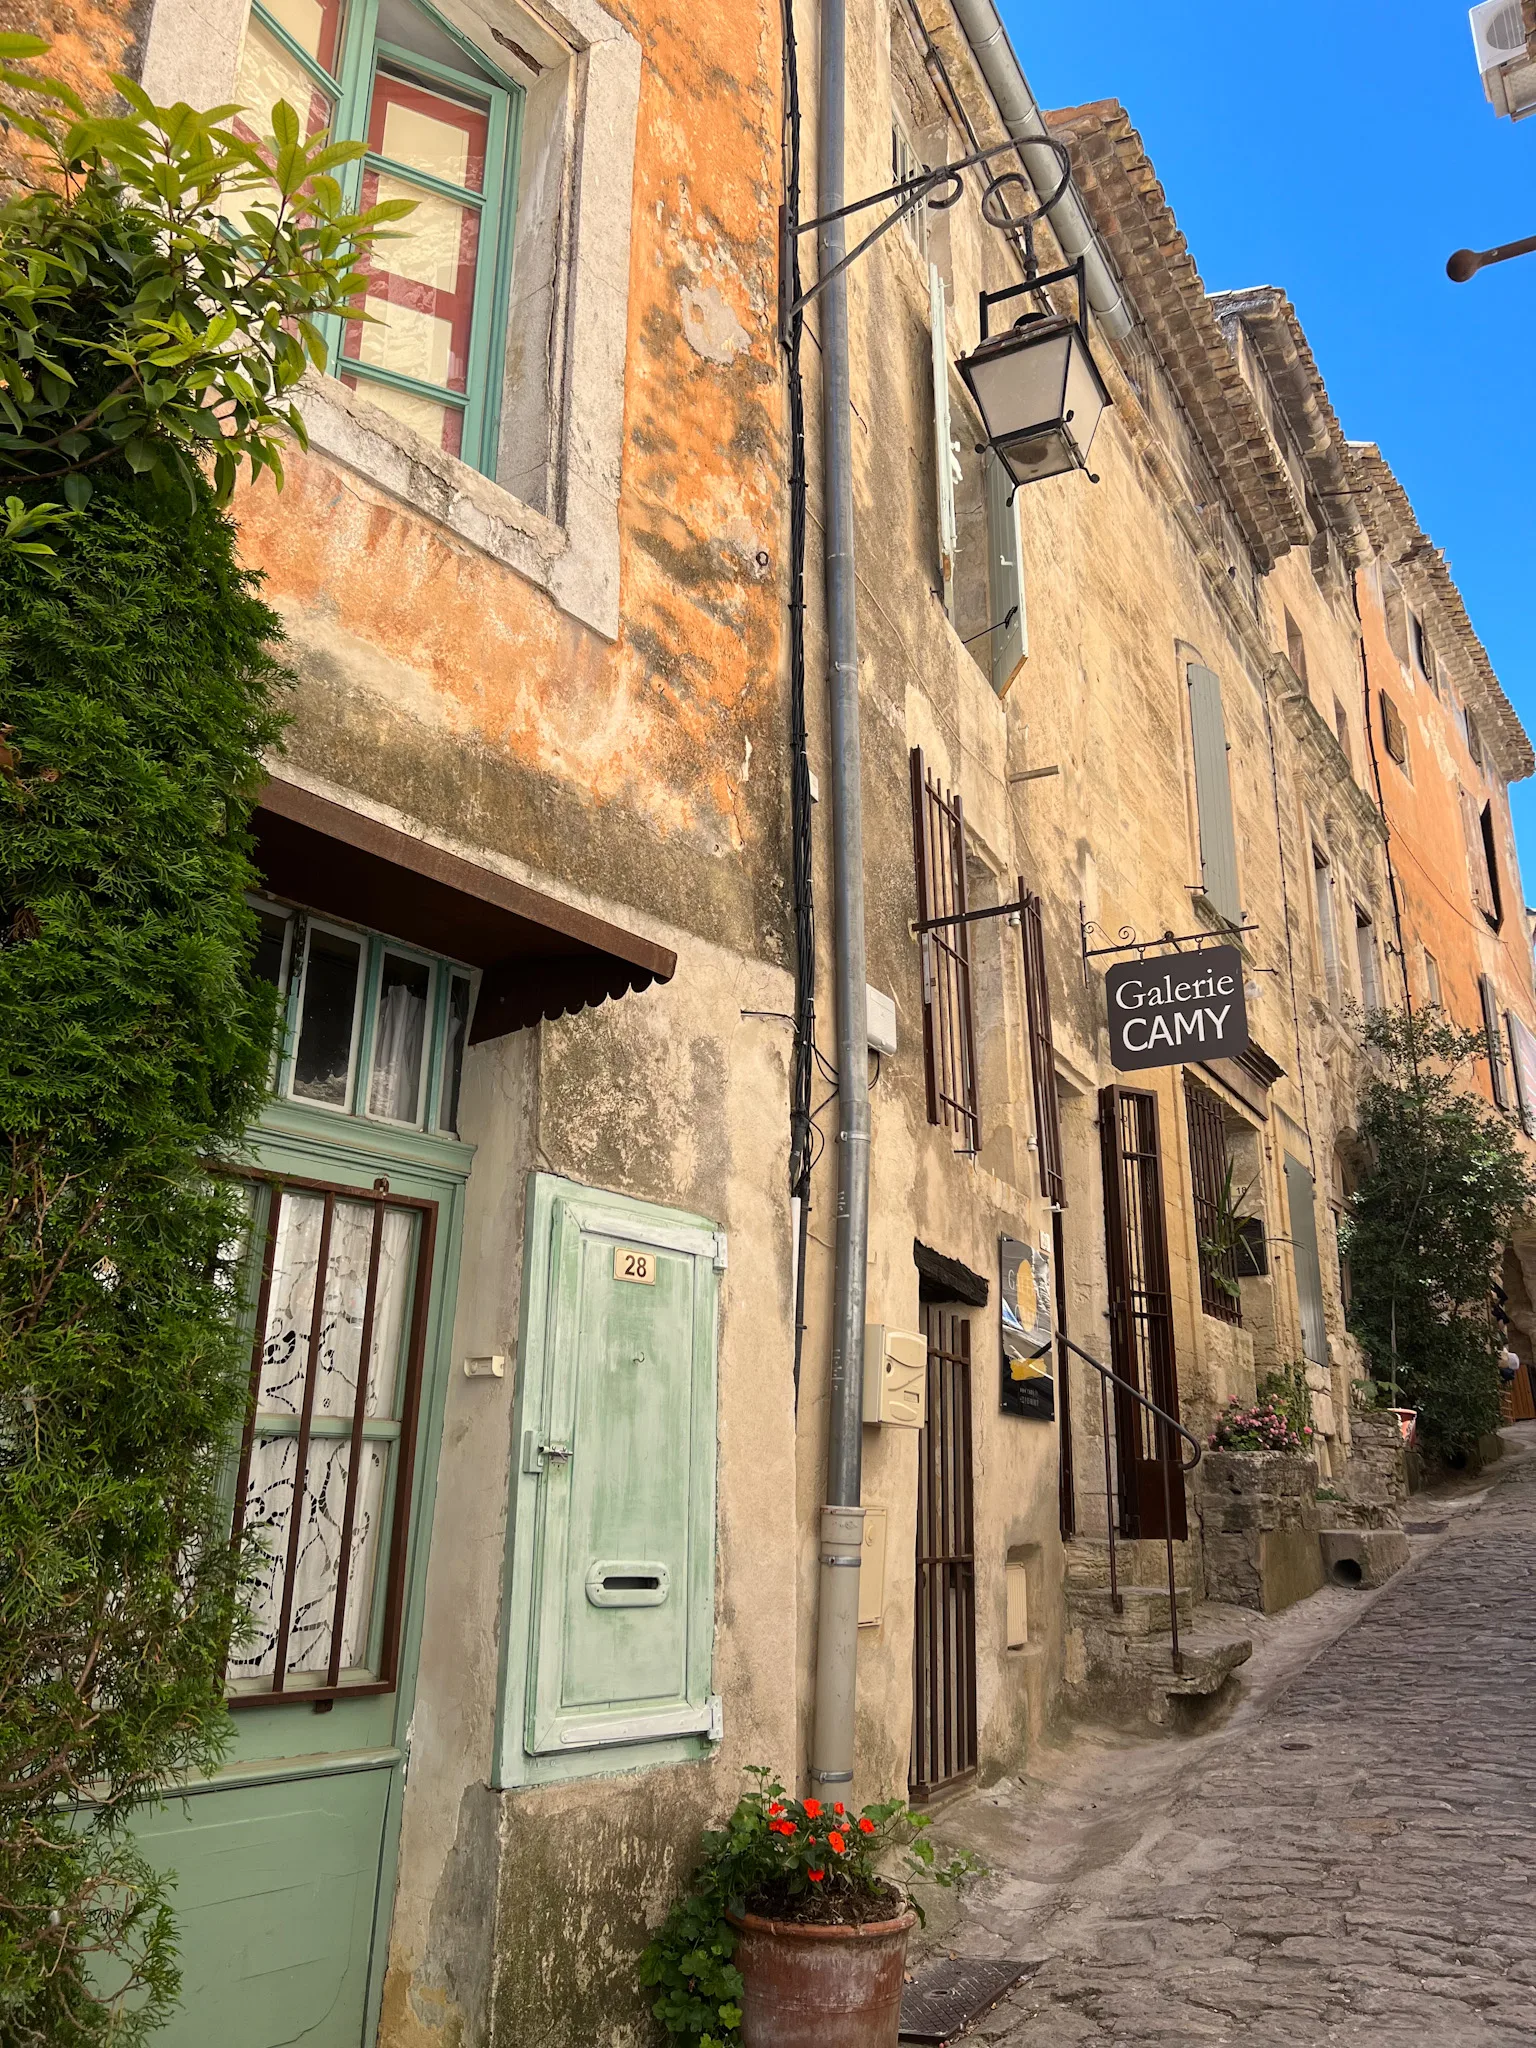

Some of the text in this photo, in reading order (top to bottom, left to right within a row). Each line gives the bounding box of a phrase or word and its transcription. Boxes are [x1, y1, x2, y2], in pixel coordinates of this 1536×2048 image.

[1115, 968, 1235, 1010] Galerie
[1122, 1004, 1231, 1051] CAMY
[624, 1254, 647, 1278] 28
